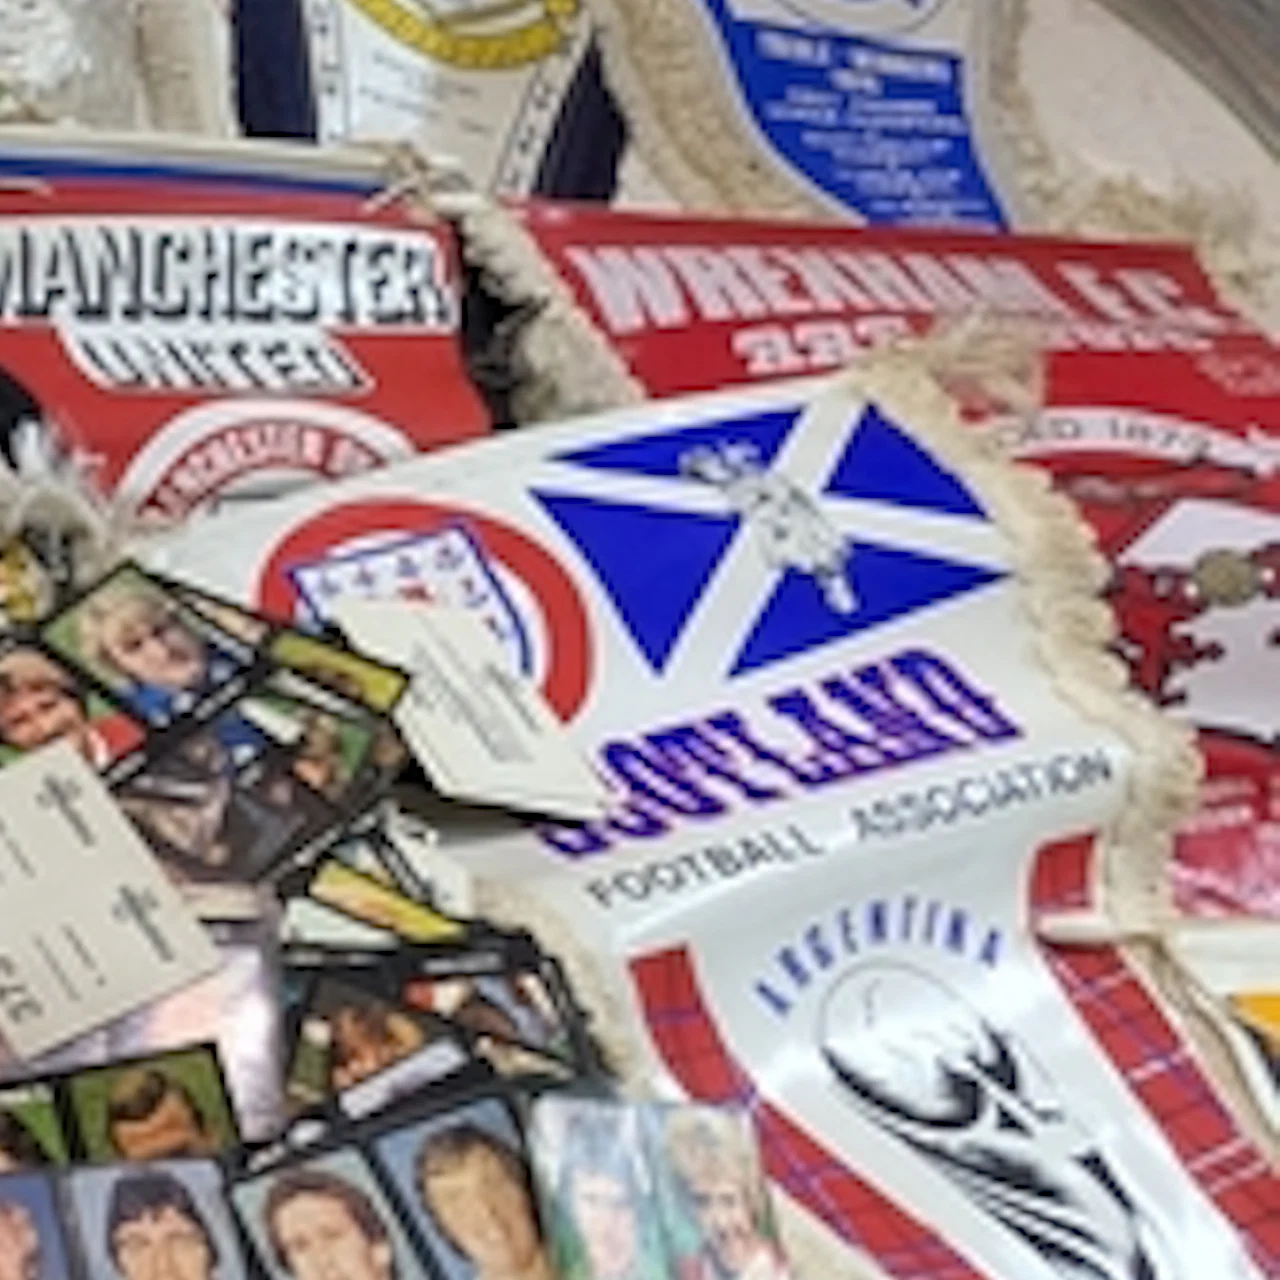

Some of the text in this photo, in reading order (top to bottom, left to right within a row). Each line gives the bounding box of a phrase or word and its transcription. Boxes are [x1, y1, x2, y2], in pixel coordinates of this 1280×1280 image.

[567, 245, 1068, 331] WREXHAM
[77, 331, 370, 390] UNITED
[589, 750, 1113, 909] FOOTBALL ASSOCIATION
[755, 896, 1002, 1016] ARGENTINA
